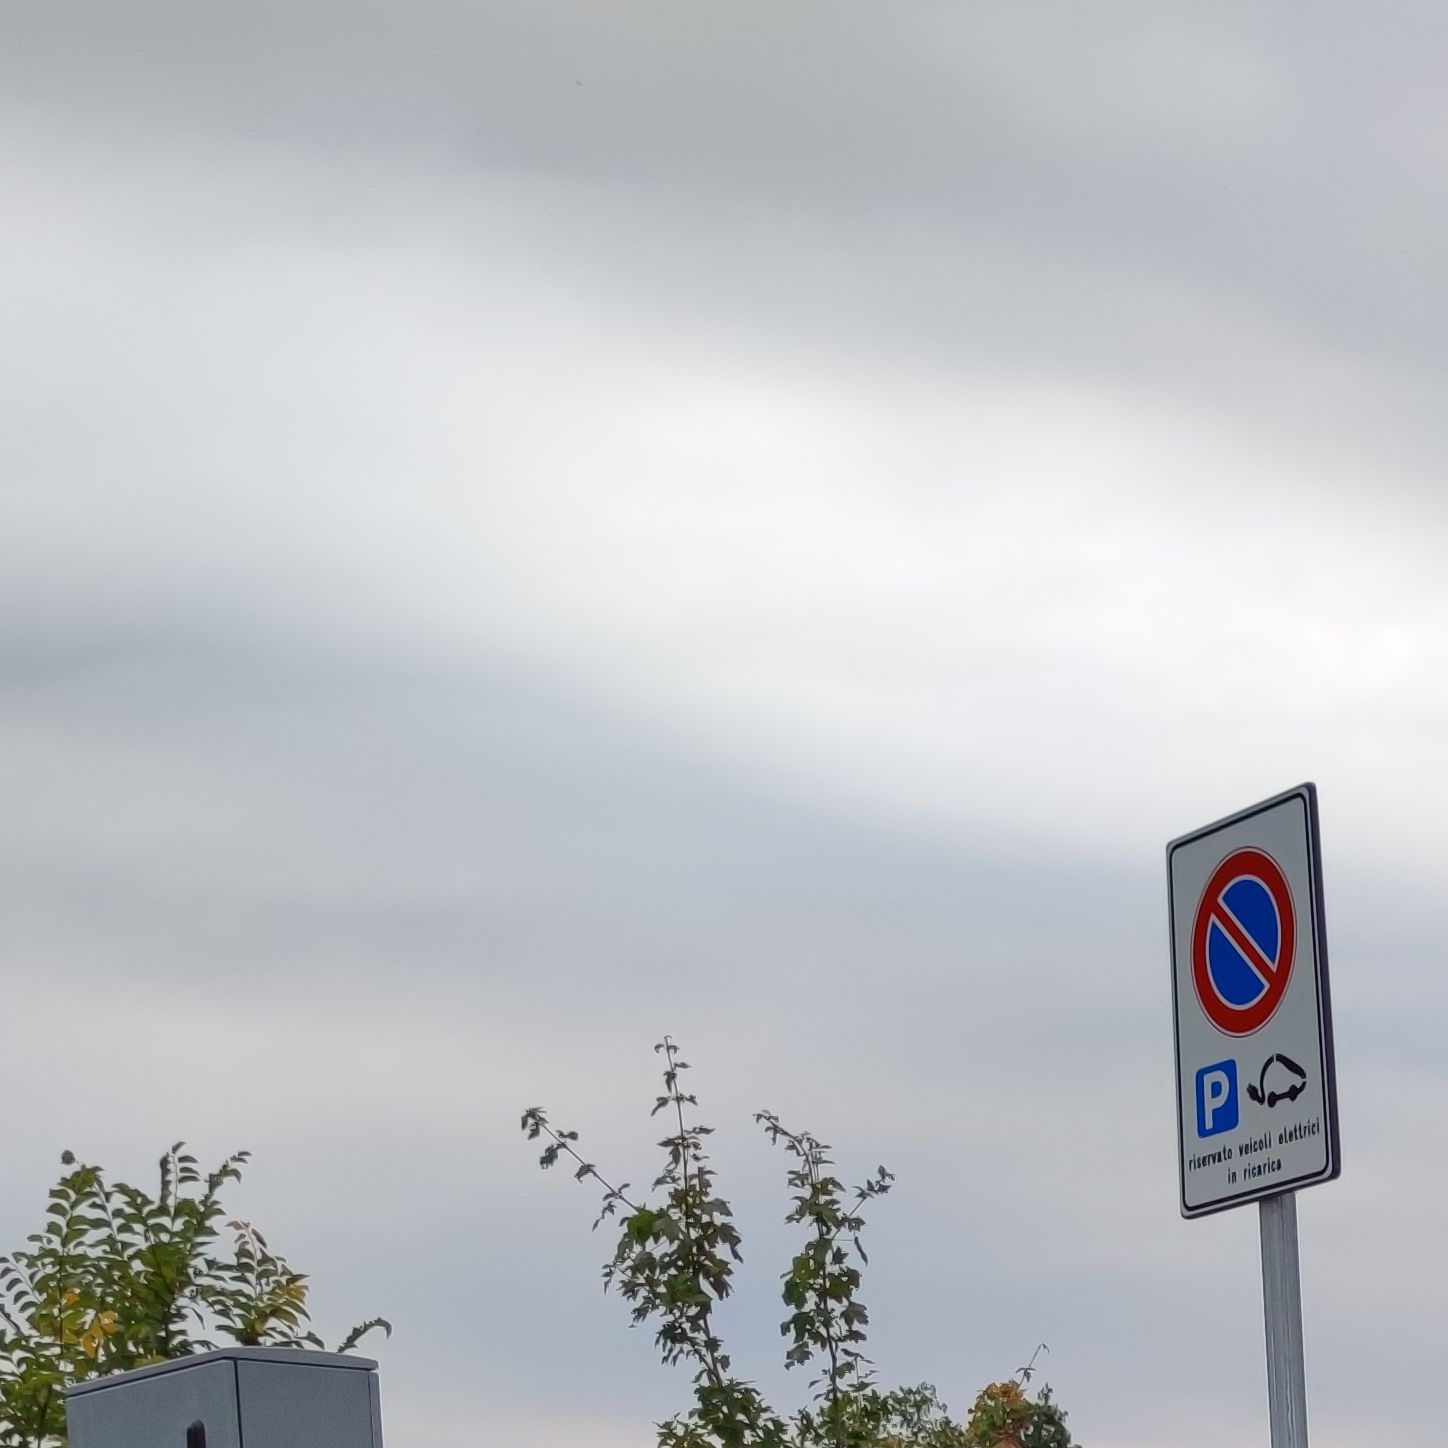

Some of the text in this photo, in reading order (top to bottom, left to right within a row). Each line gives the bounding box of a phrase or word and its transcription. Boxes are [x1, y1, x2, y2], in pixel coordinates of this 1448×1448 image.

[1203, 1069, 1230, 1131] P
[1188, 1117, 1320, 1172] riservato veicoli elettrici
[1227, 1157, 1282, 1185] in ricarica
